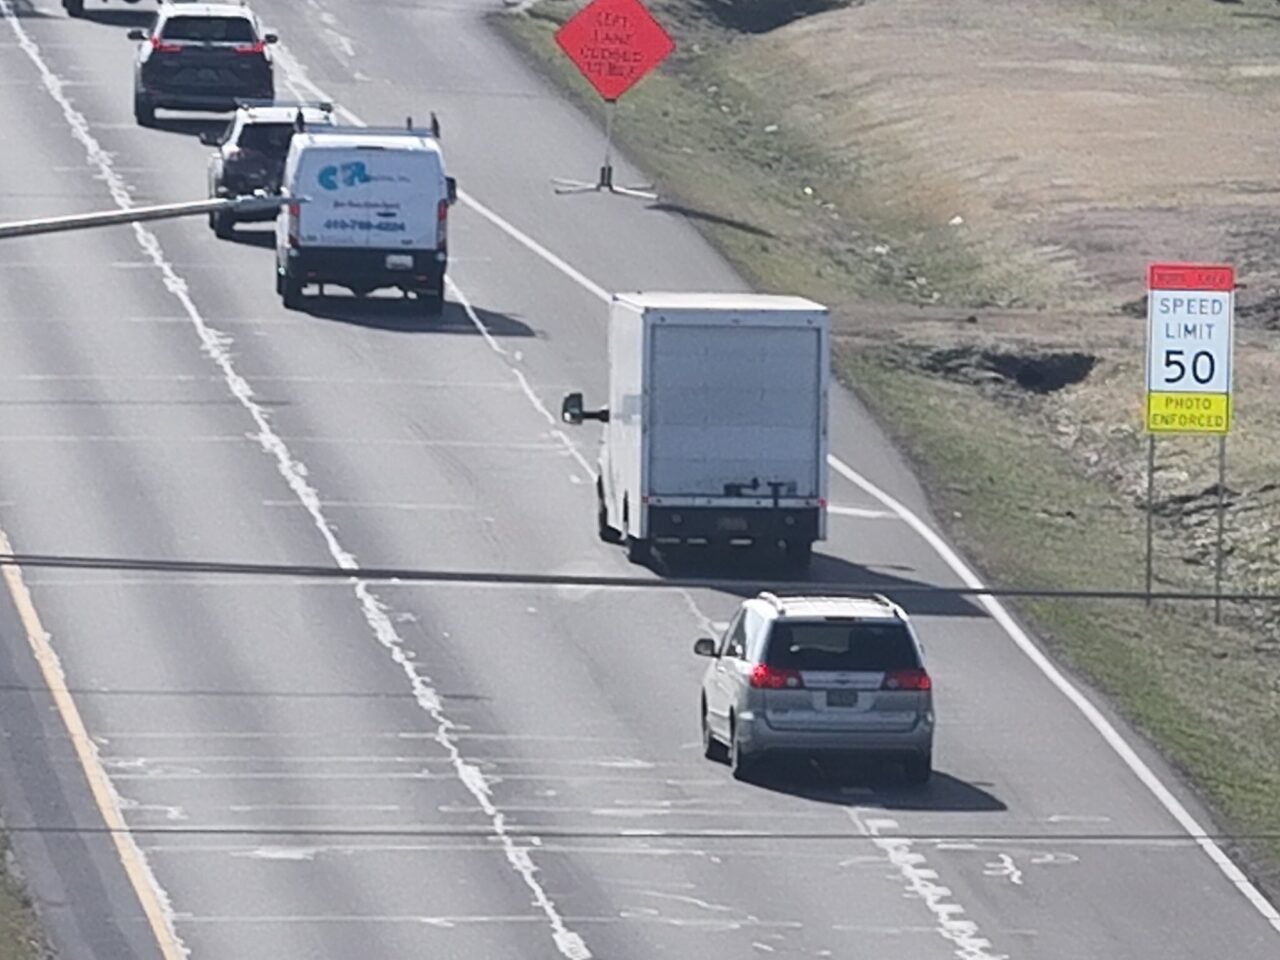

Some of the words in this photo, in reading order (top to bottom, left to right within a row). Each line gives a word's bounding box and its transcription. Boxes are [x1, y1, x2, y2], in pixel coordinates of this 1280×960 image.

[1159, 297, 1224, 315] SPEED
[1164, 321, 1216, 340] LIMIT
[1163, 349, 1216, 385] 50
[1164, 396, 1213, 411] PHOTO
[1151, 412, 1225, 428] ENFORCED
